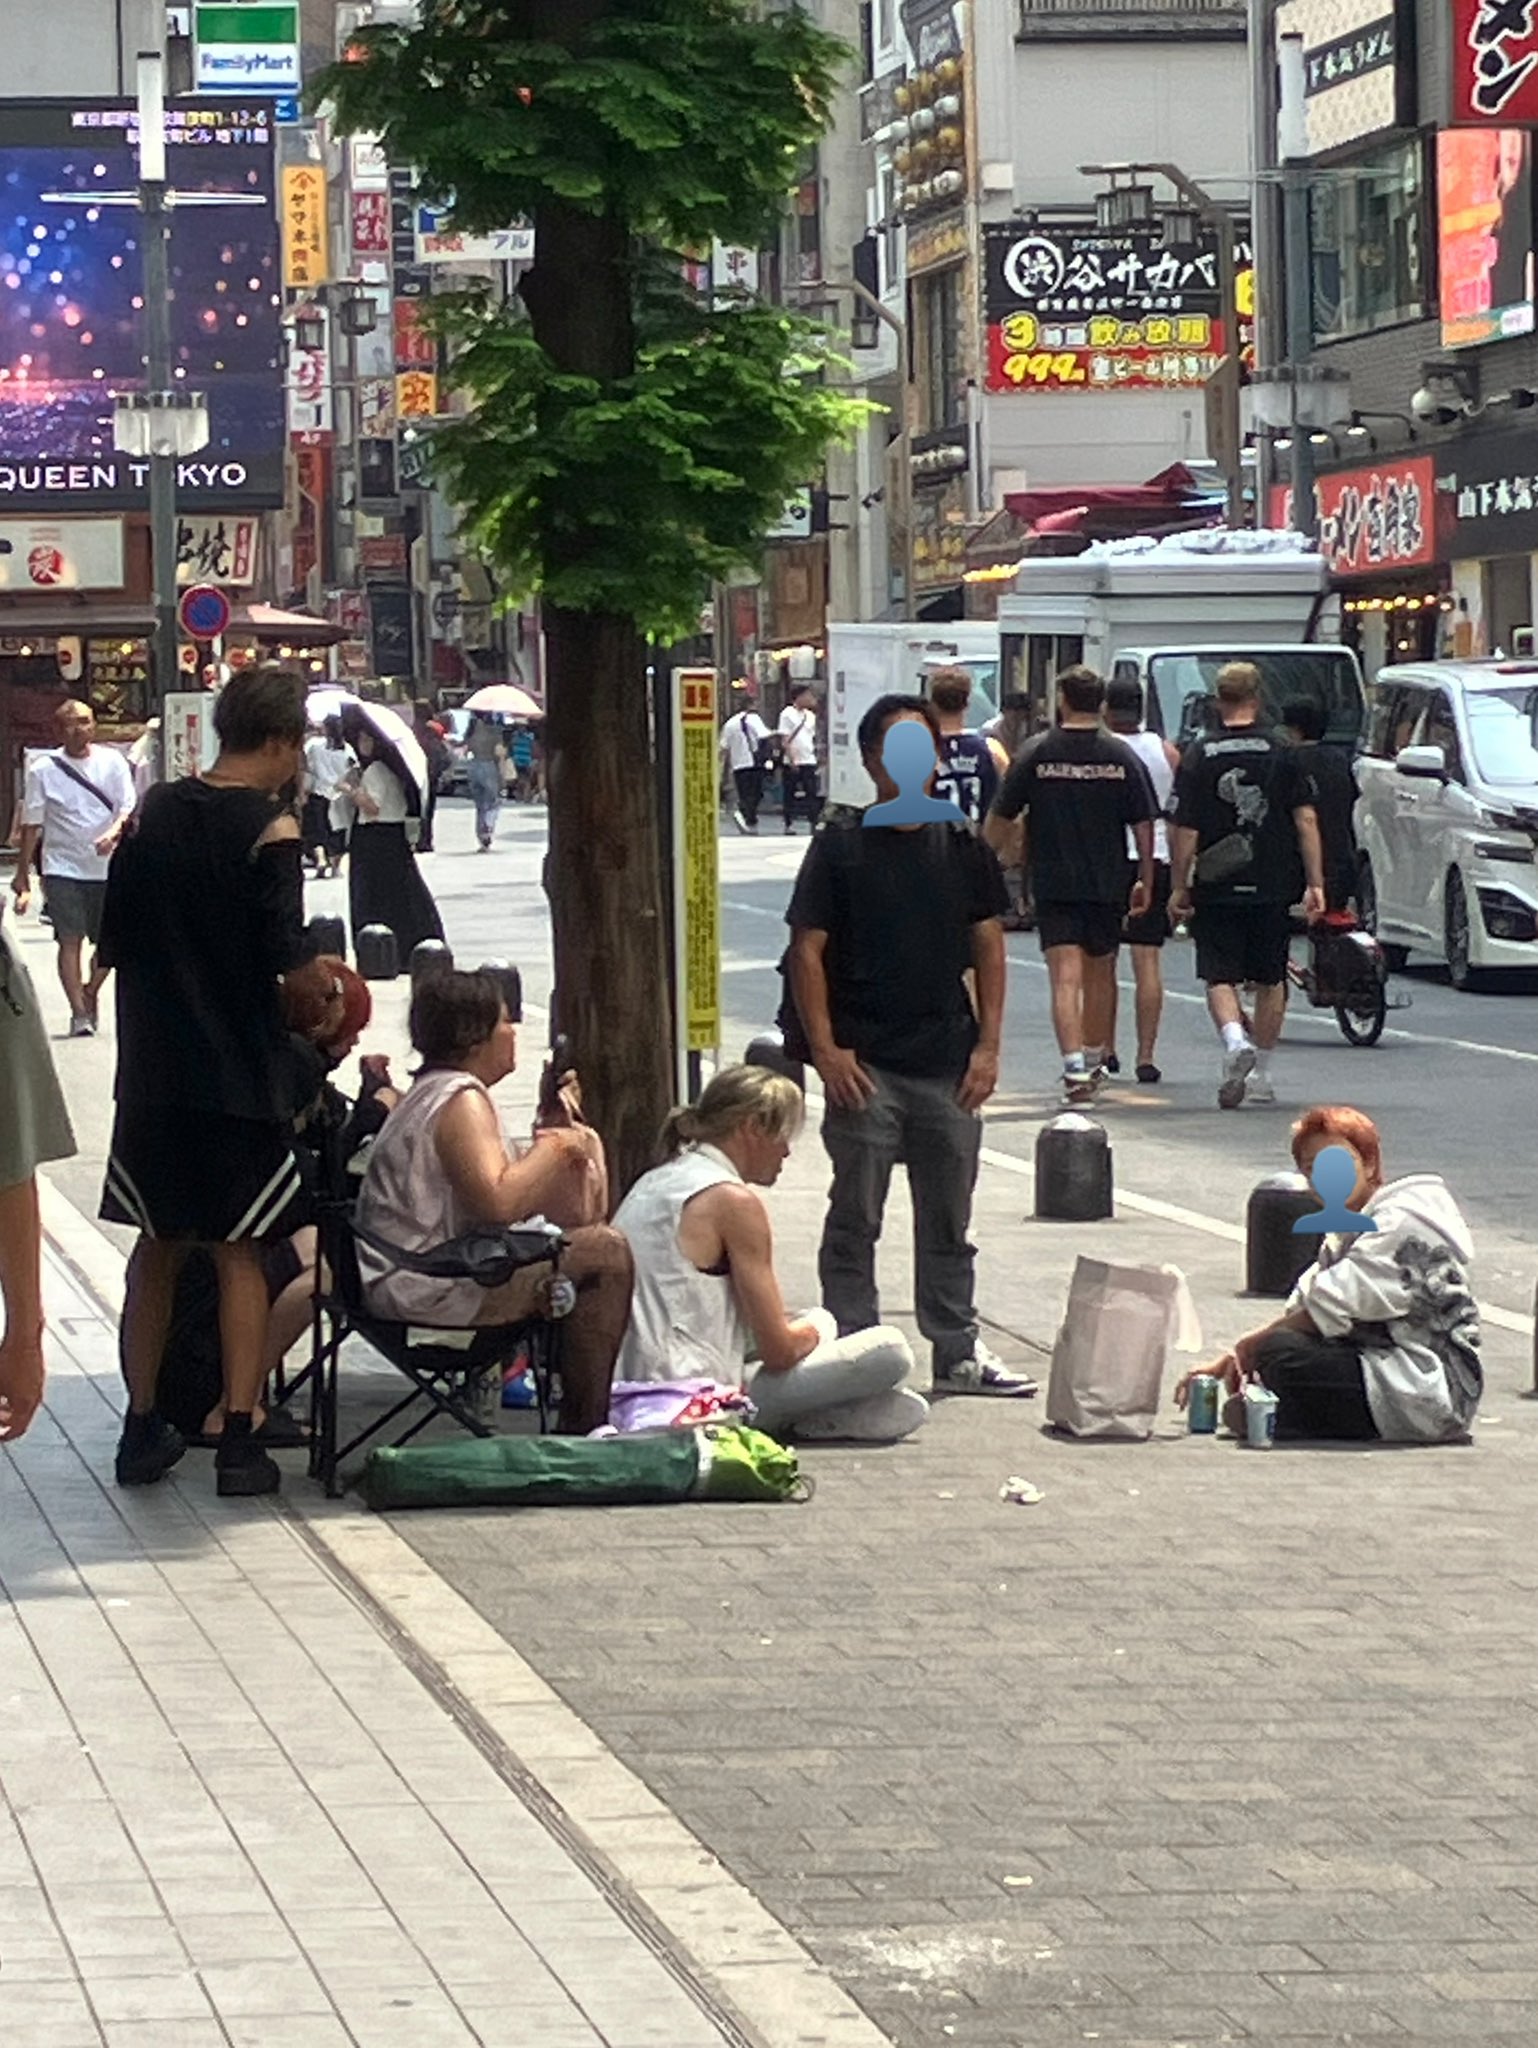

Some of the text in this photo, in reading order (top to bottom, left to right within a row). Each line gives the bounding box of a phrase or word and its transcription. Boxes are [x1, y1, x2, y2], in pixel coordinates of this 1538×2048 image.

[201, 53, 293, 72] FamilyMart
[1004, 238, 1216, 297] 渋谷サカバ
[0, 462, 246, 491] QUEEN TKYO
